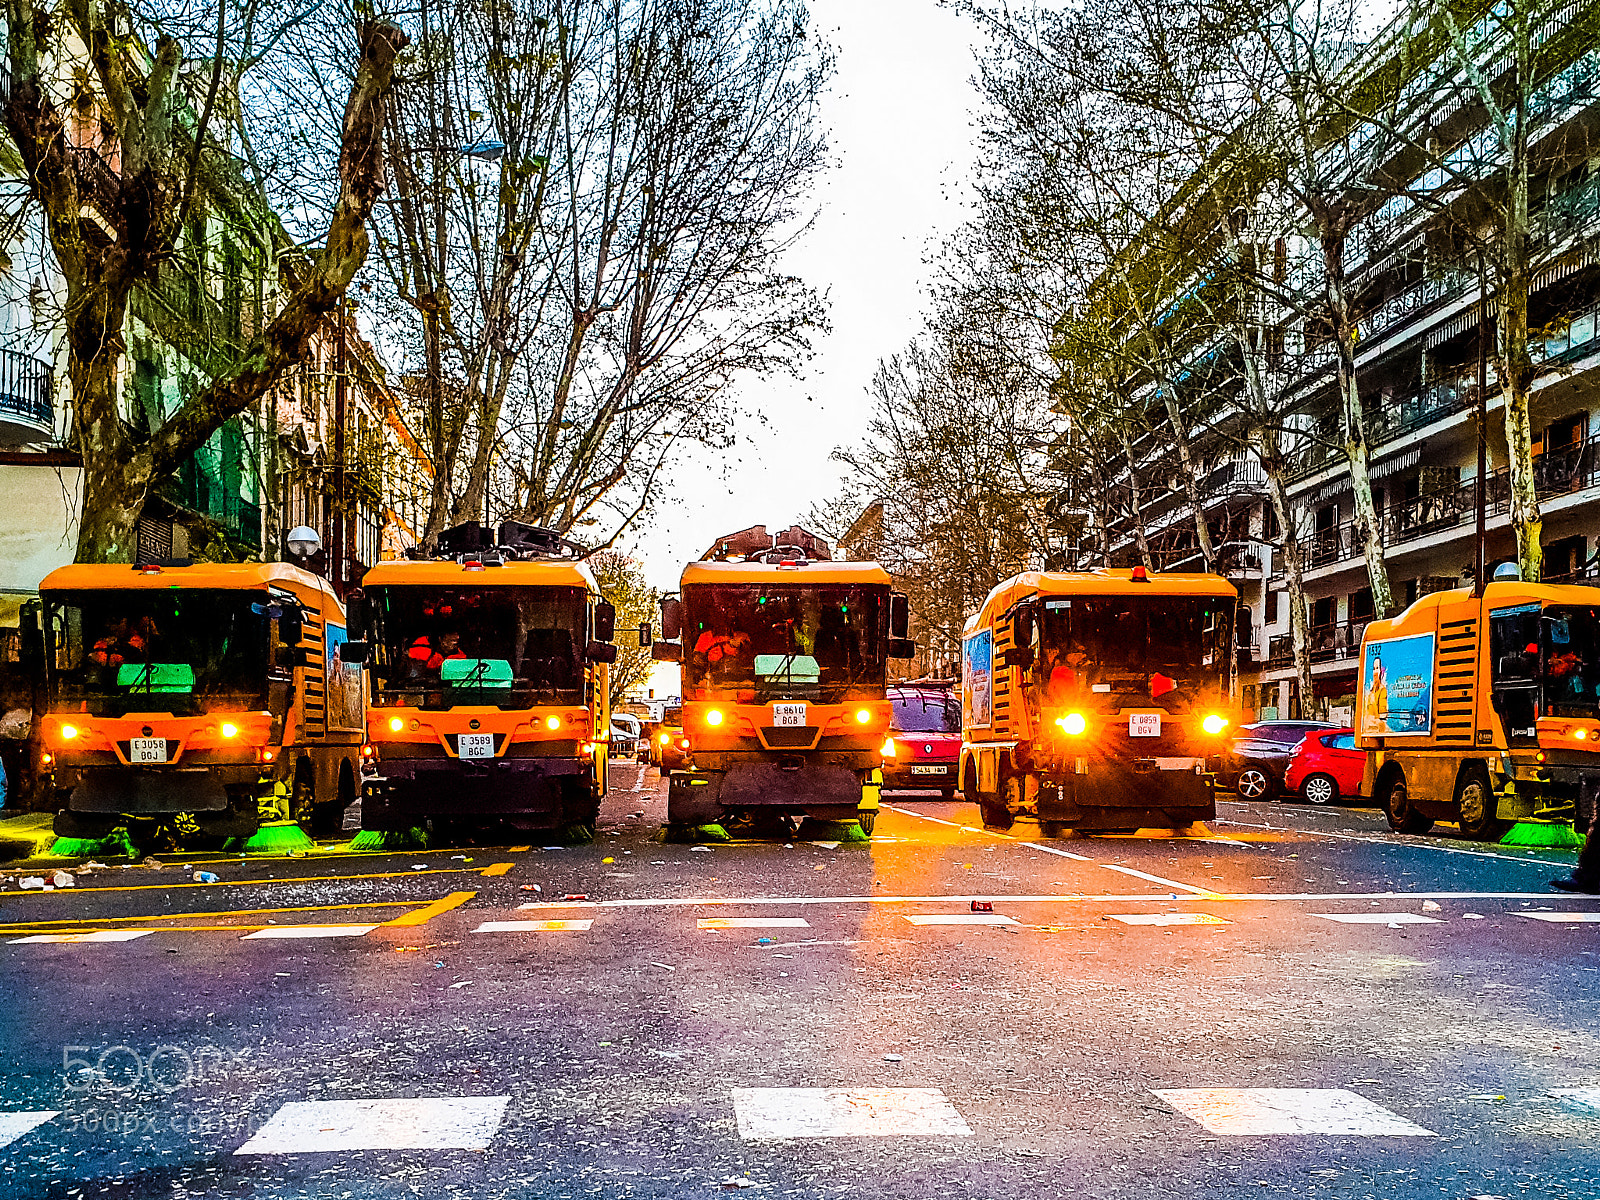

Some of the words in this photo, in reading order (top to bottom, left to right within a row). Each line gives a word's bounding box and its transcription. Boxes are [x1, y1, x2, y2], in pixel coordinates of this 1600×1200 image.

[783, 705, 804, 714] 8610
[782, 716, 798, 725] BGB
[1139, 715, 1157, 724] 0859
[141, 740, 164, 749] 3058
[469, 736, 490, 745] 3589
[140, 751, 158, 760] BGJ
[468, 747, 485, 756] BGC
